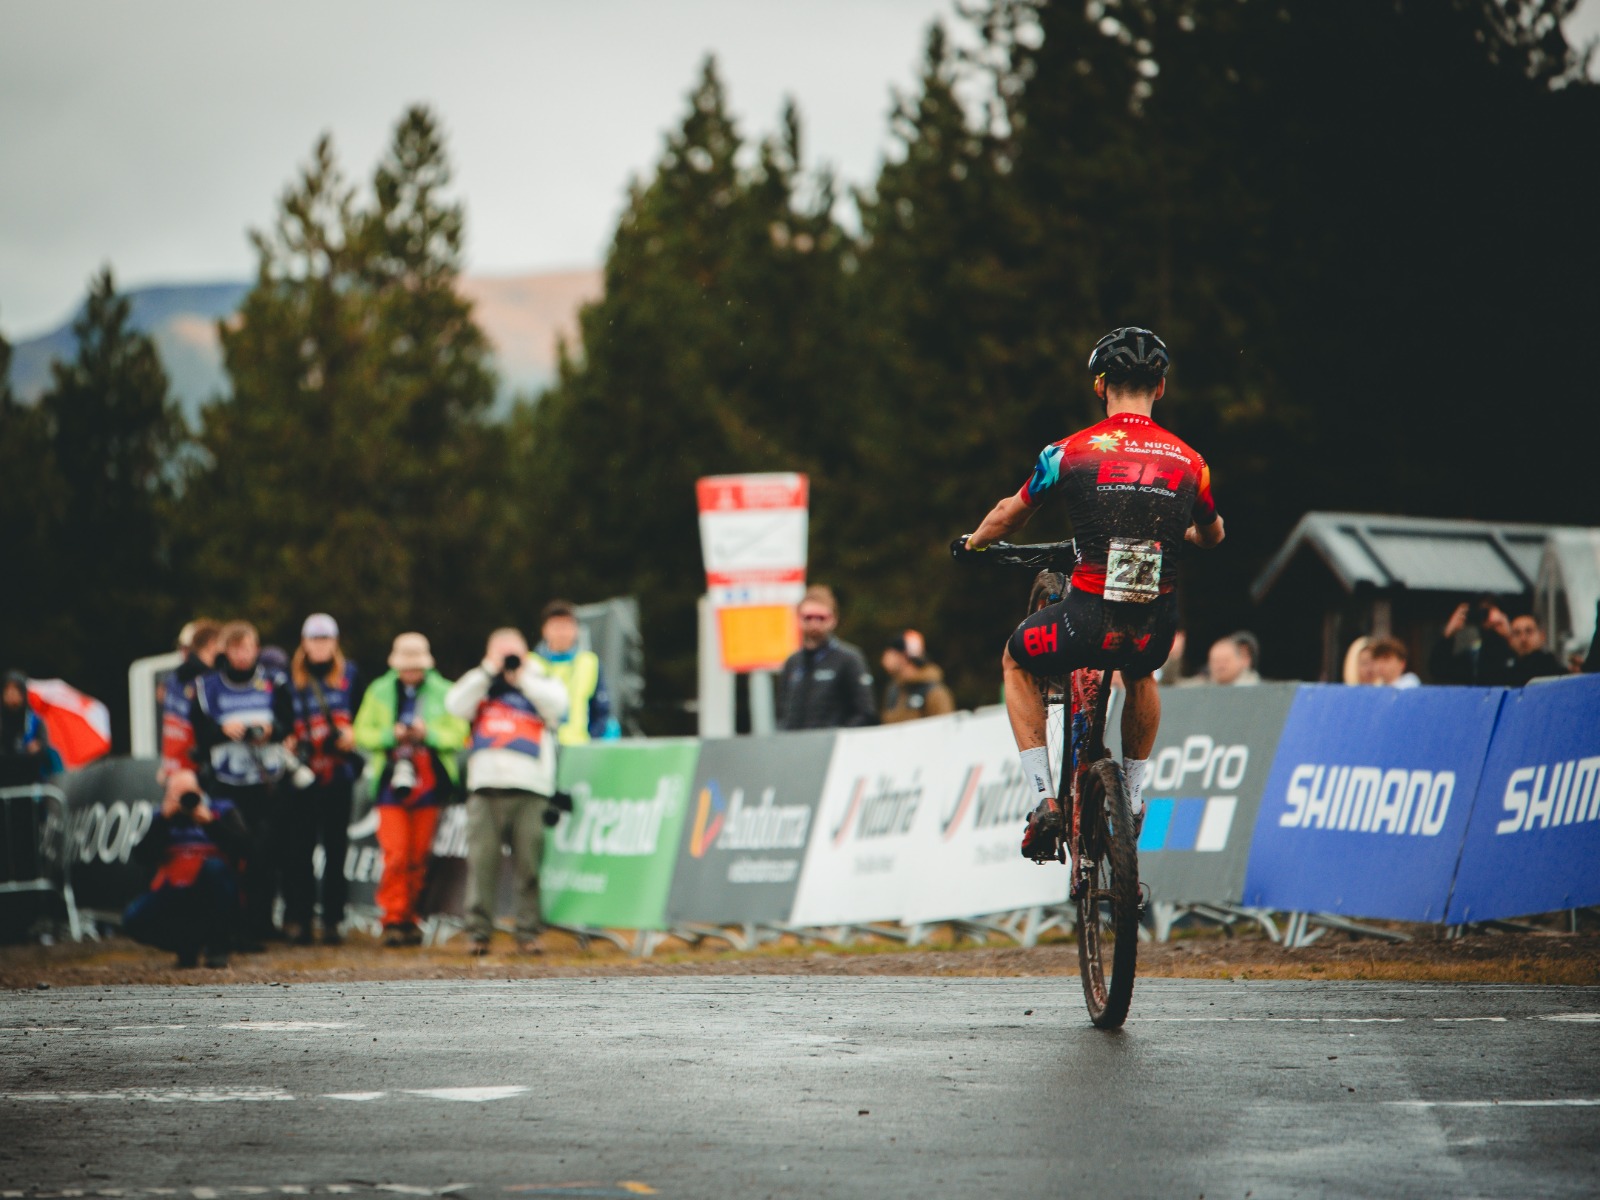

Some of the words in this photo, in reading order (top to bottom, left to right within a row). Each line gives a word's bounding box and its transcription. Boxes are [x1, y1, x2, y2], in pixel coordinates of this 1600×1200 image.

[1124, 446, 1151, 454] CIUDAD
[1165, 451, 1192, 465] DEPORTE
[1096, 460, 1185, 491] BH
[1096, 484, 1136, 492] COLOMA
[1023, 622, 1058, 657] BH
[1279, 764, 1456, 837] SHIMANO
